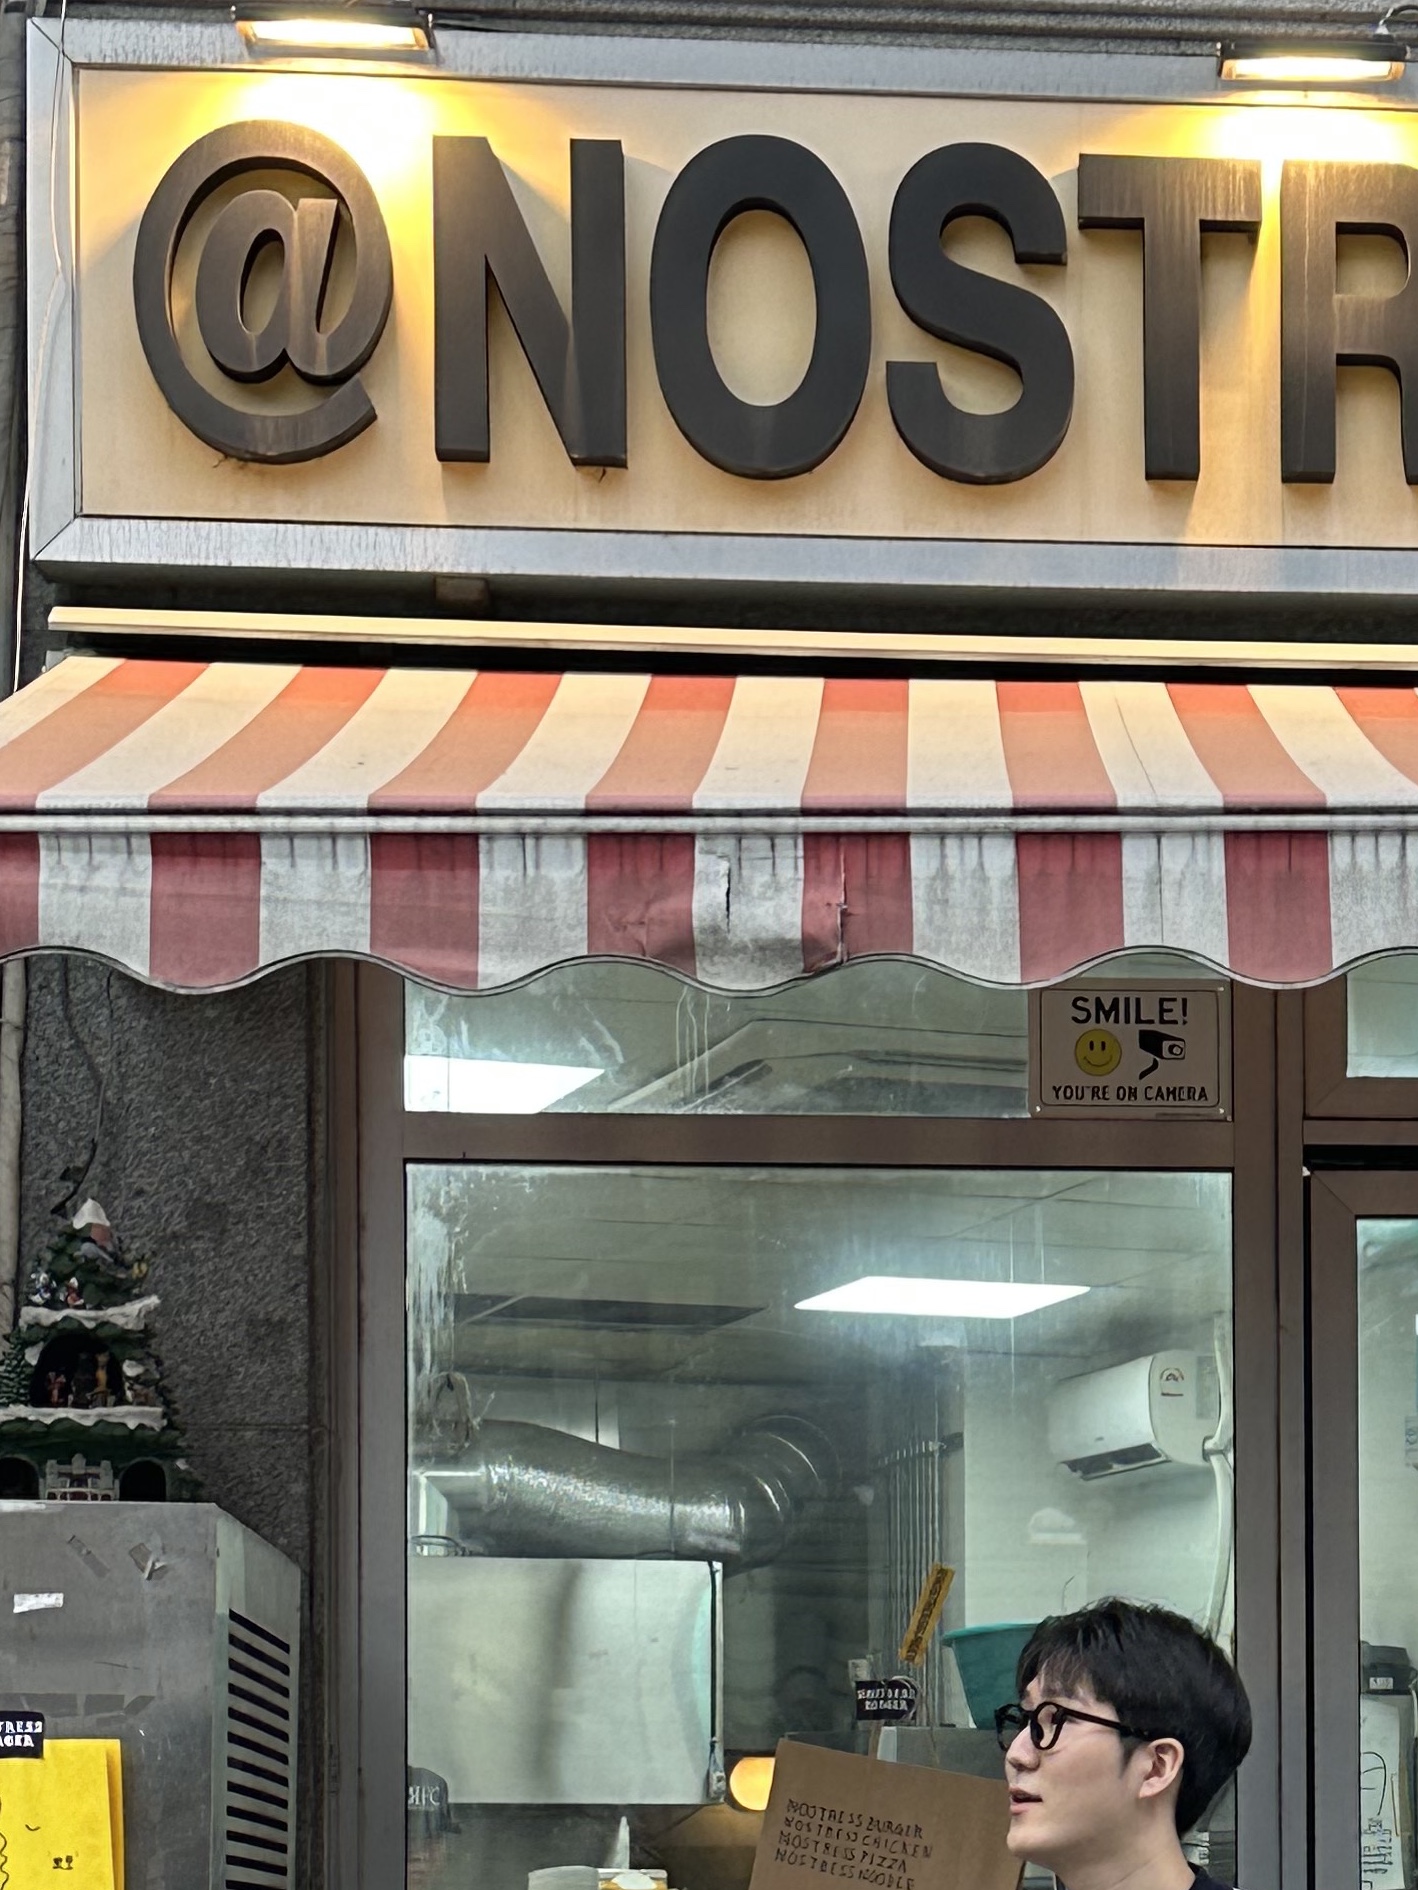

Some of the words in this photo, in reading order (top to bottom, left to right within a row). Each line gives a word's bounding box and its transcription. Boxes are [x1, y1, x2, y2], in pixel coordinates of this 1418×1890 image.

[1071, 996, 1189, 1026] SMILE!
[1052, 1084, 1110, 1102] YOU'RE
[1116, 1085, 1138, 1102] ON
[1144, 1085, 1209, 1103] CAMERA
